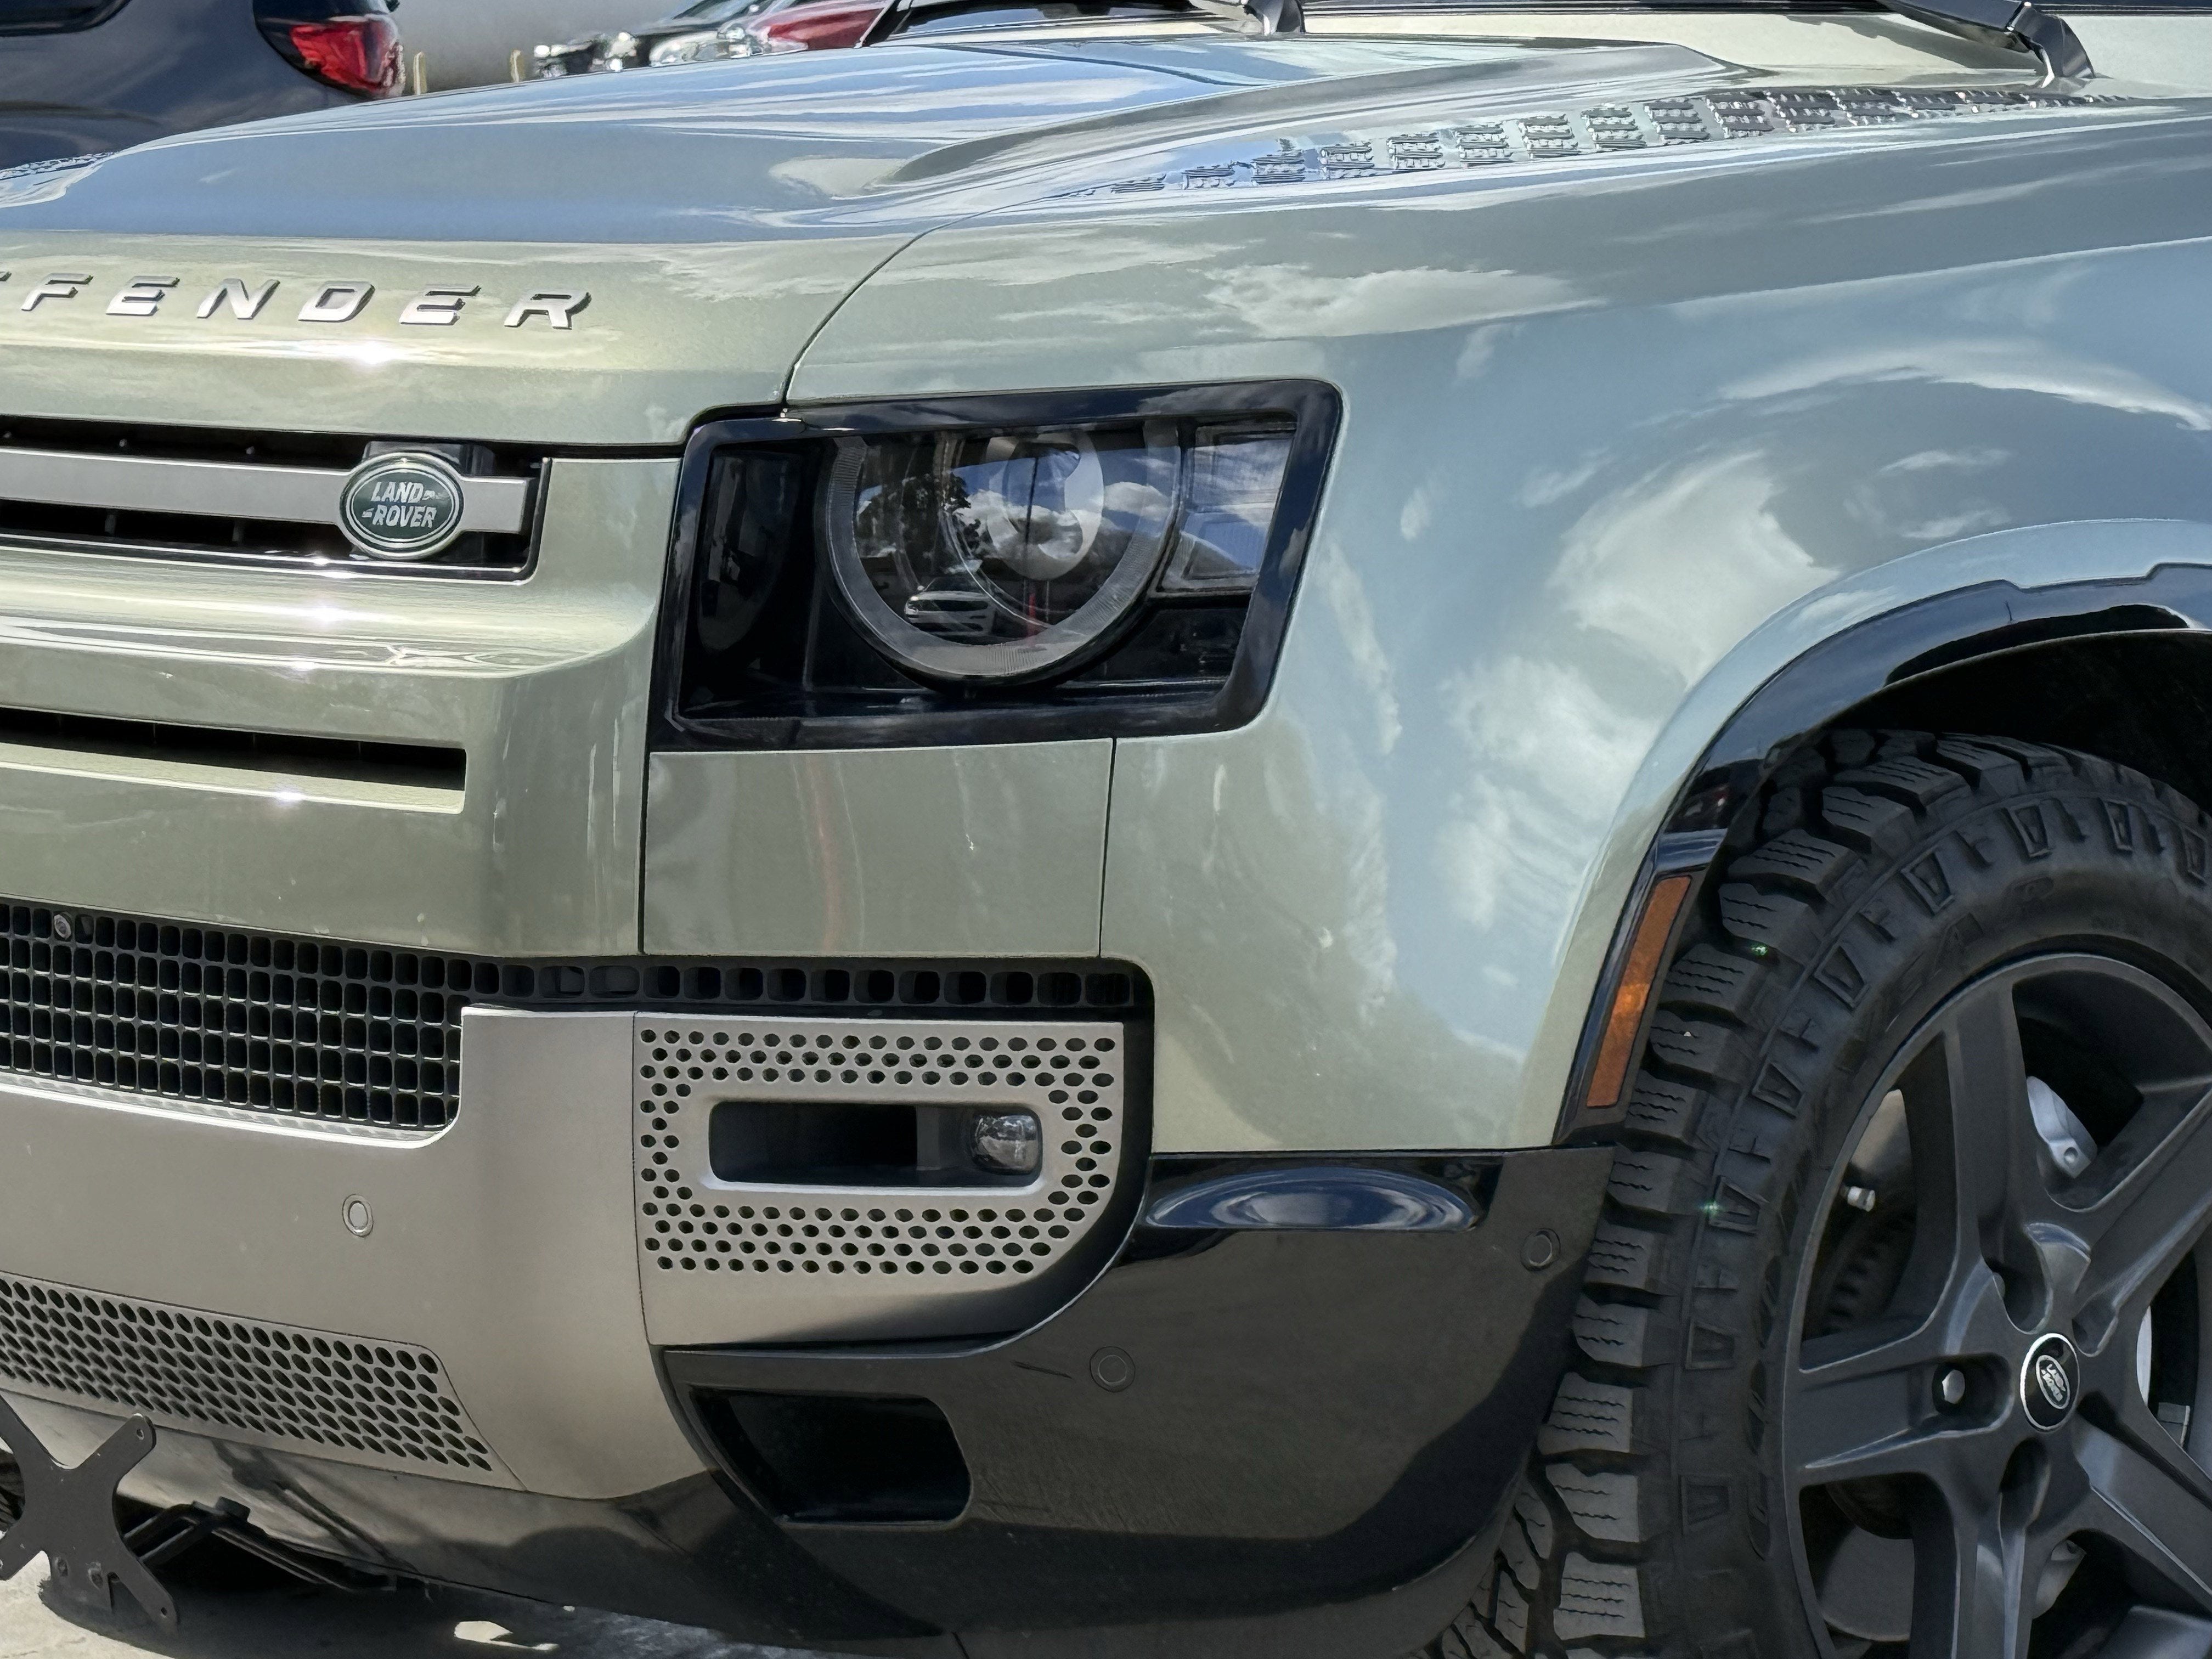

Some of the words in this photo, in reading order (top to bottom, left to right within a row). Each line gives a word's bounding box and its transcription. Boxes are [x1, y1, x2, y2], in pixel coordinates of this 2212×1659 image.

[0, 271, 591, 330] FENDER
[370, 481, 424, 503] LAND
[372, 505, 437, 528] ROVER
